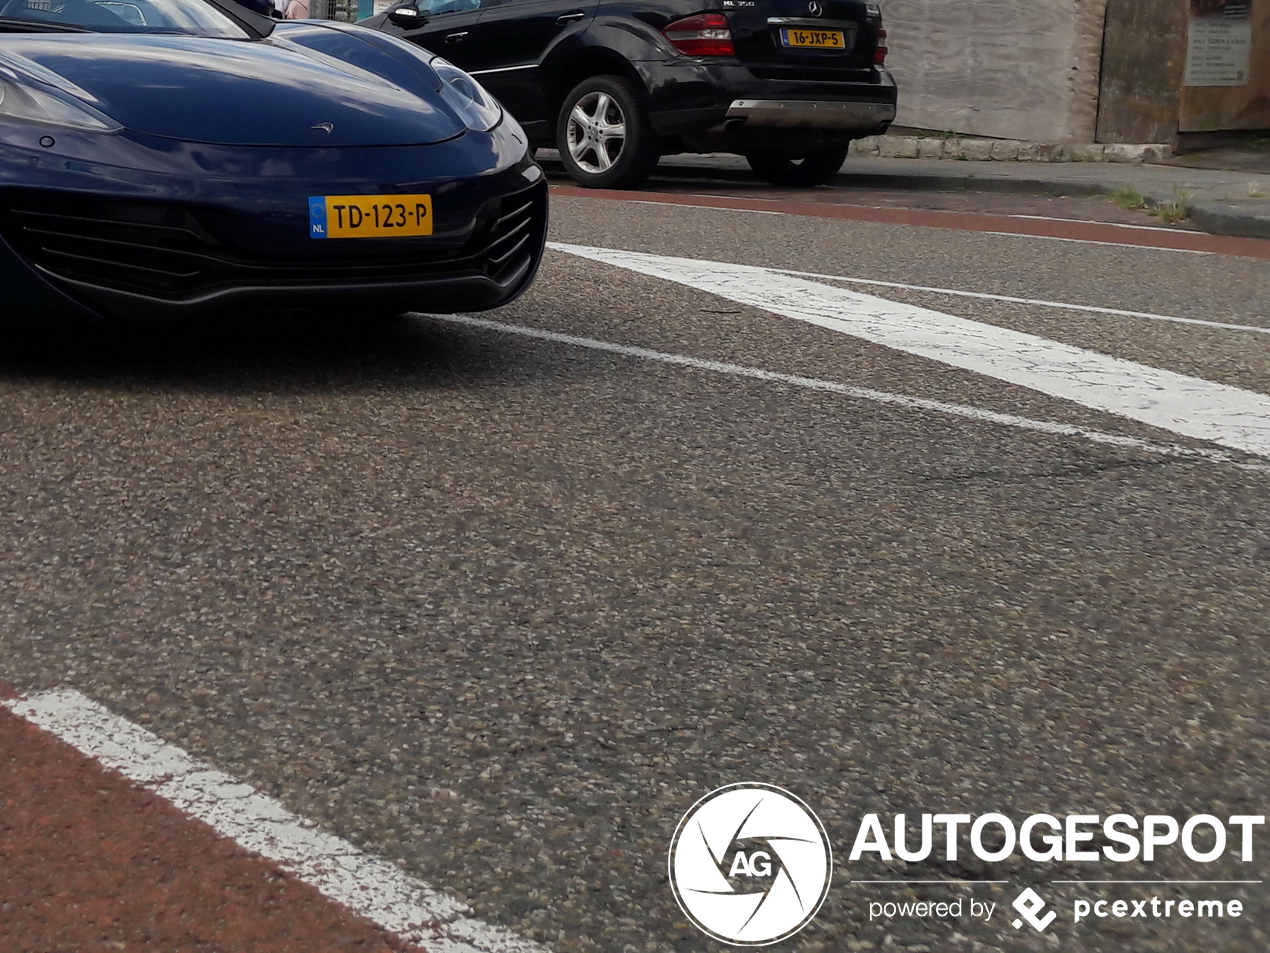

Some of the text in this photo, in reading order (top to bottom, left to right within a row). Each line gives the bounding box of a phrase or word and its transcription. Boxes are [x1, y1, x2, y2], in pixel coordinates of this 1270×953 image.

[793, 31, 839, 45] 16-JXP-5
[313, 203, 427, 233] NL TD-123-P
